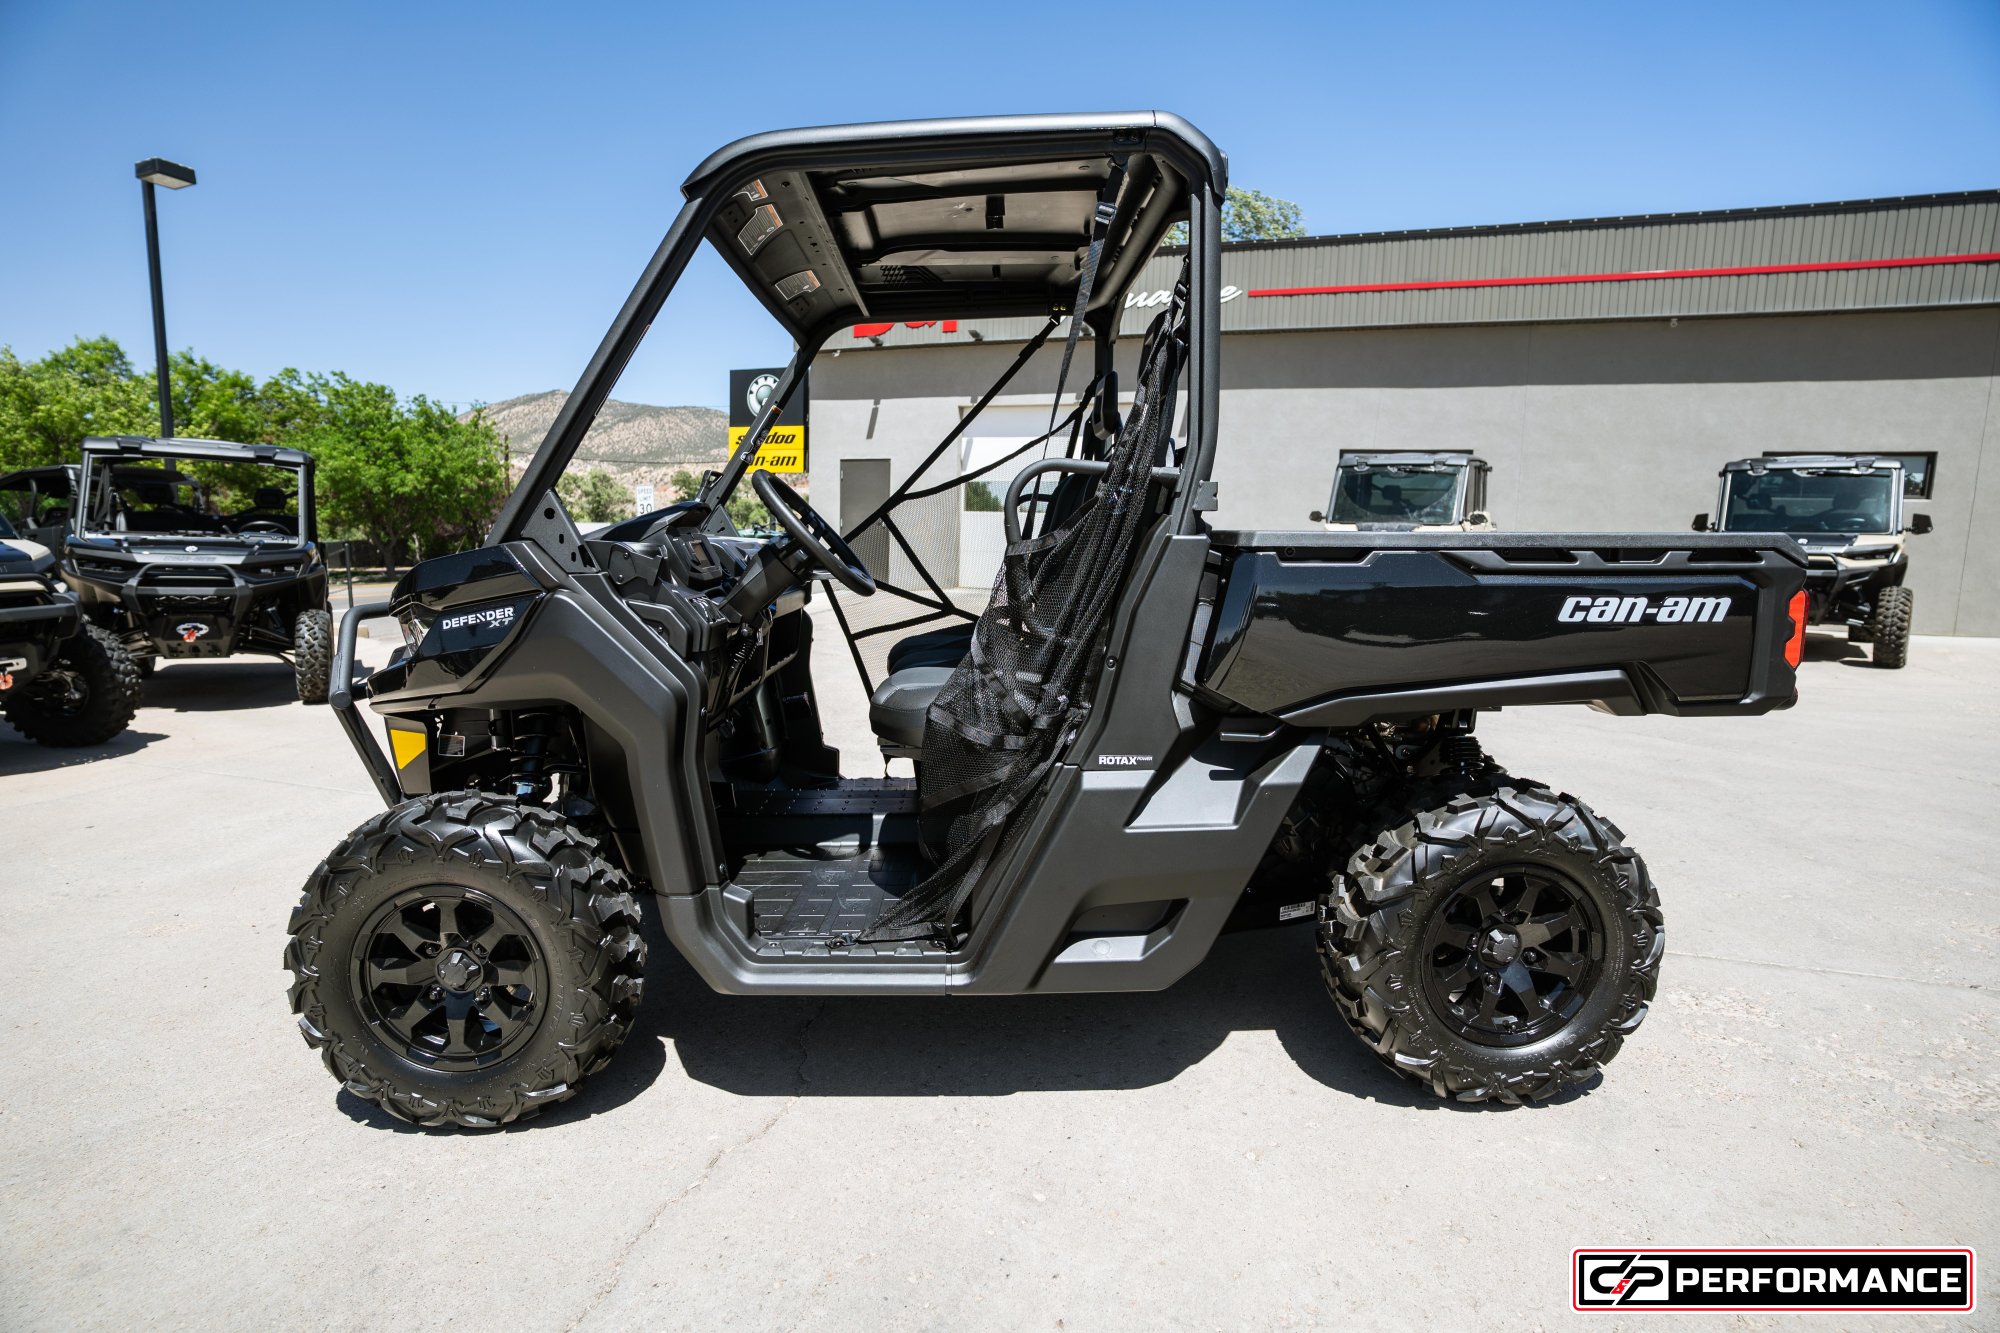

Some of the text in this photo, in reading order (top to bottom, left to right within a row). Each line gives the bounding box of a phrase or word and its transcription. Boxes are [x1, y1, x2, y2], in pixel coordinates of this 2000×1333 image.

[639, 503, 653, 515] 30
[1557, 596, 1732, 623] can-am
[442, 607, 514, 630] DEFENDER
[488, 616, 514, 628] XT
[1098, 756, 1137, 765] ROTAX
